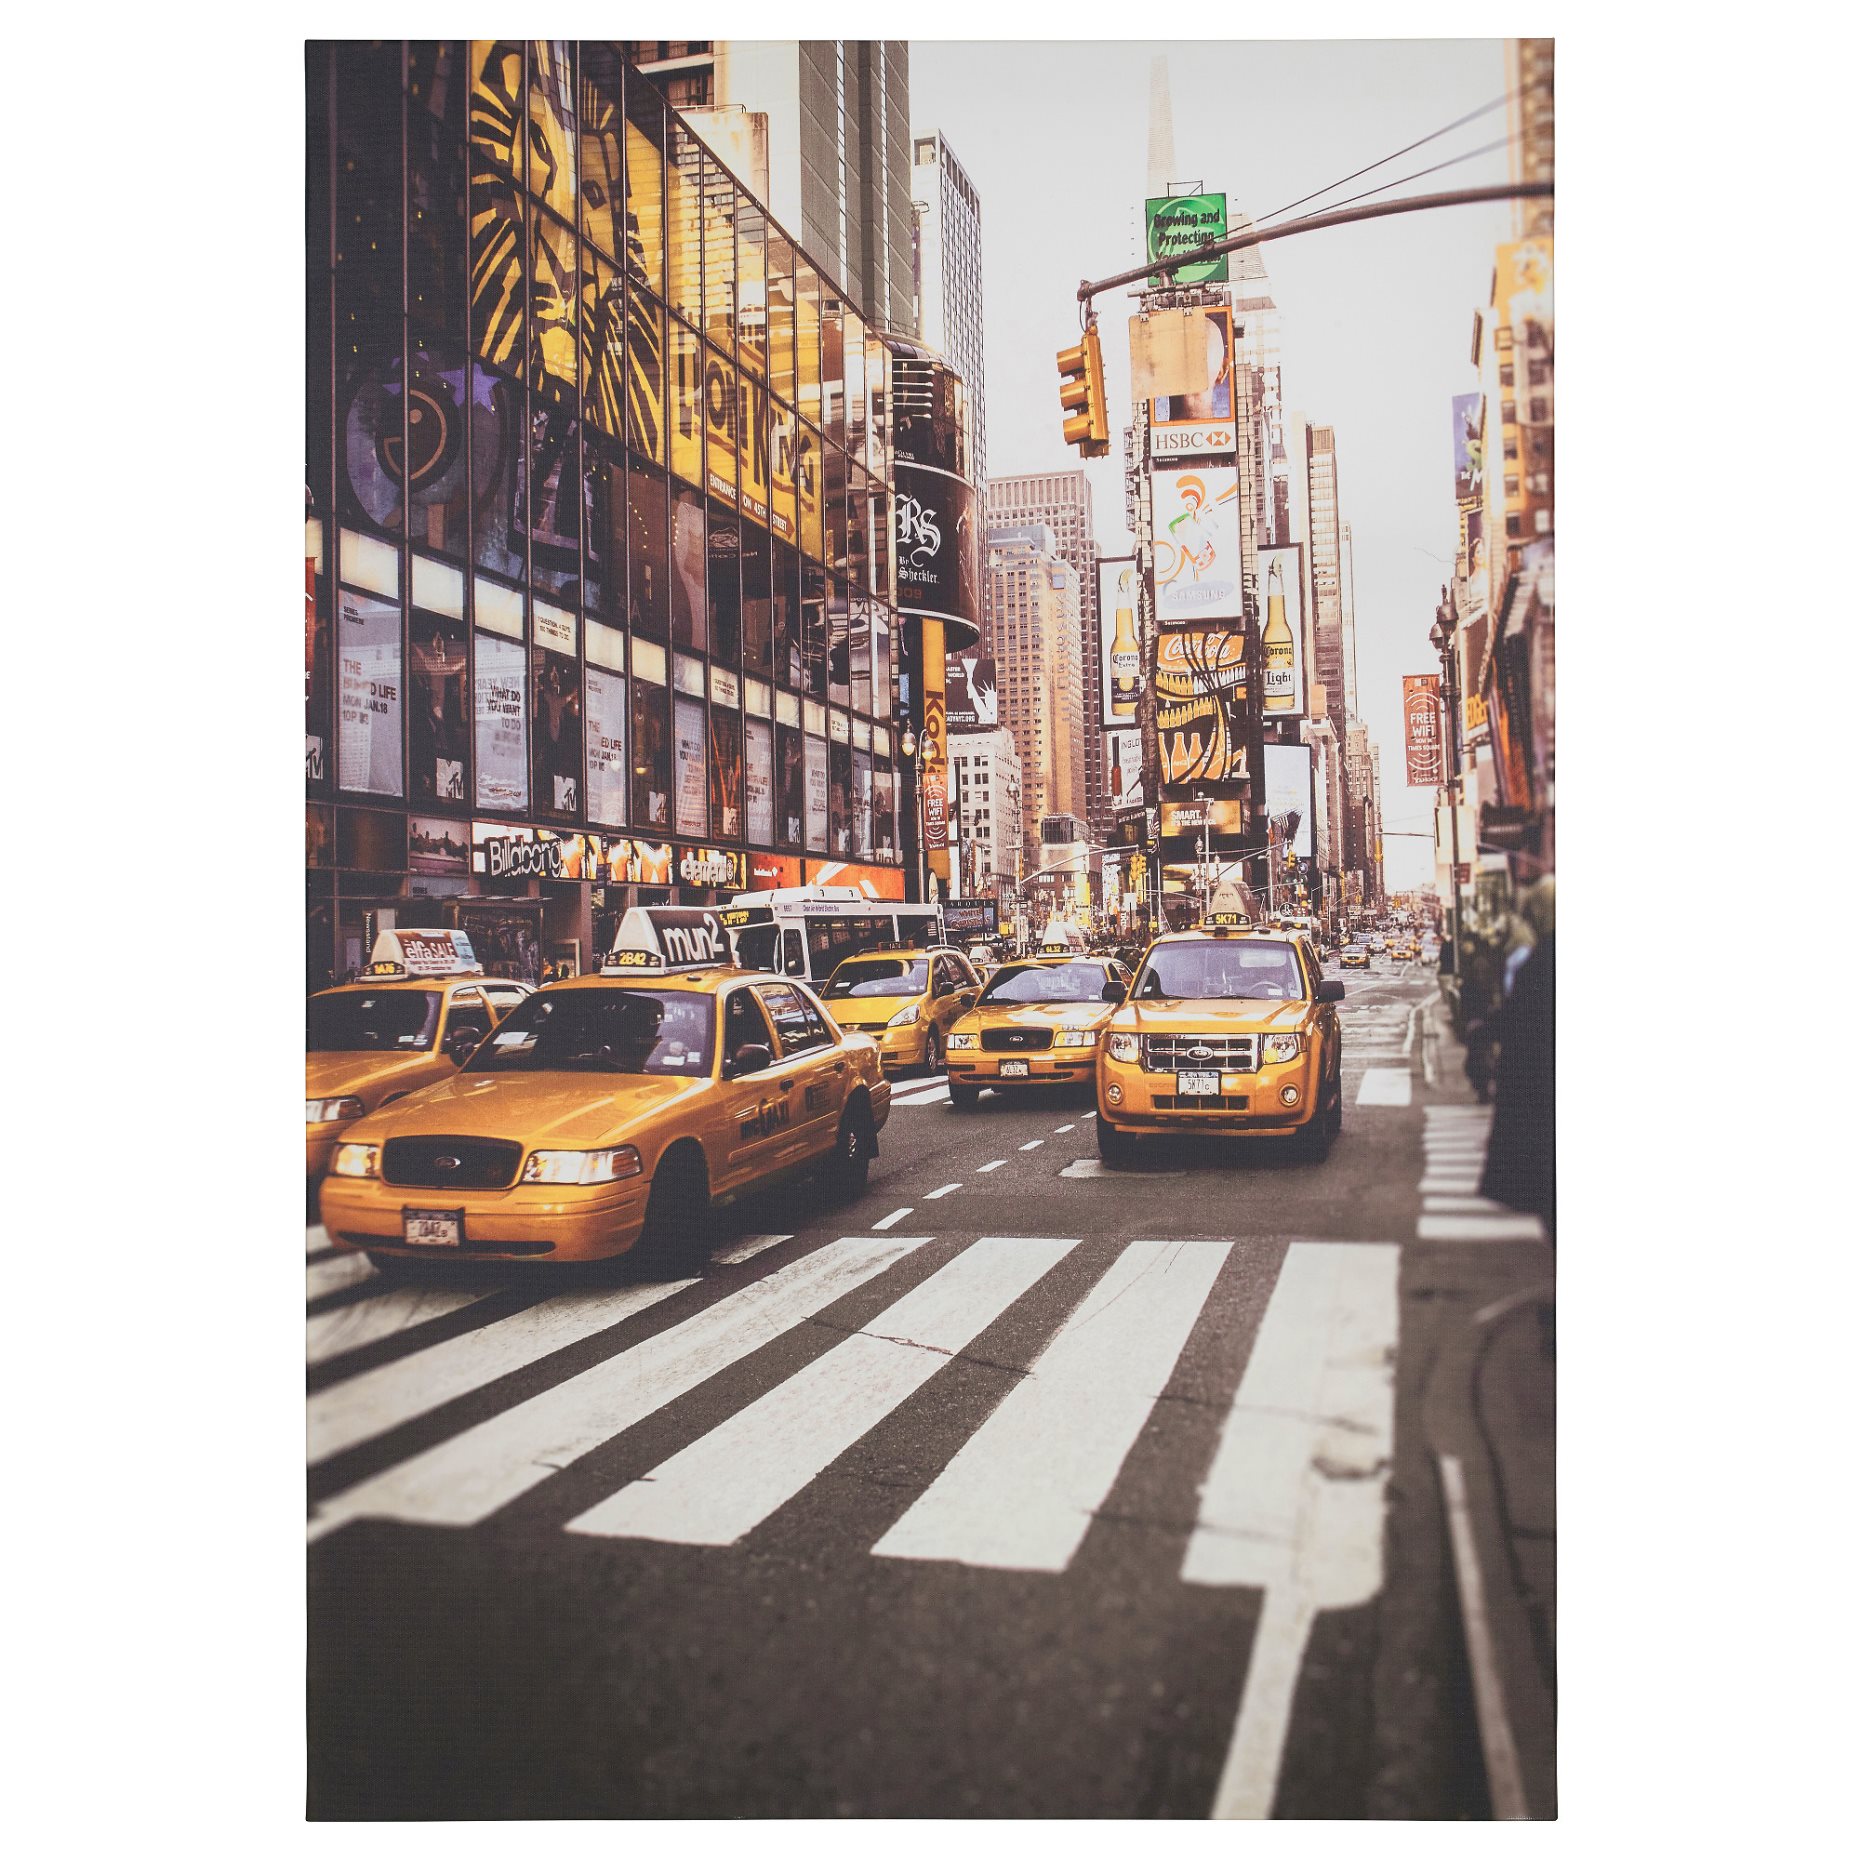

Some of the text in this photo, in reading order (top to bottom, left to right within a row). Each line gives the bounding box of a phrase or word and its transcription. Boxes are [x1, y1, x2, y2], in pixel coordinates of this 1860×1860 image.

[1154, 208, 1220, 228] Growing and
[1159, 229, 1214, 247] Protecting
[1156, 432, 1204, 449] HSBC
[709, 474, 736, 500] ENTRANCE
[743, 495, 752, 510] ON
[773, 513, 787, 532] STREET
[1171, 590, 1225, 600] SAMSUNG
[1113, 653, 1139, 664] Corona
[343, 659, 362, 675] THE
[1266, 670, 1291, 686] Light
[379, 684, 396, 701] LIFE
[511, 690, 521, 703] DO
[1410, 712, 1436, 725] FREE
[1413, 725, 1436, 737] WIFI
[611, 738, 622, 751] LIFE
[1422, 744, 1440, 752] SQUARE
[927, 798, 944, 808] FREE
[928, 807, 943, 817] WIFI
[1171, 810, 1202, 820] SMART.
[490, 837, 562, 878] Billabong
[1215, 914, 1237, 925] 5K71
[430, 942, 456, 959] SALE
[618, 952, 647, 966] 2B42
